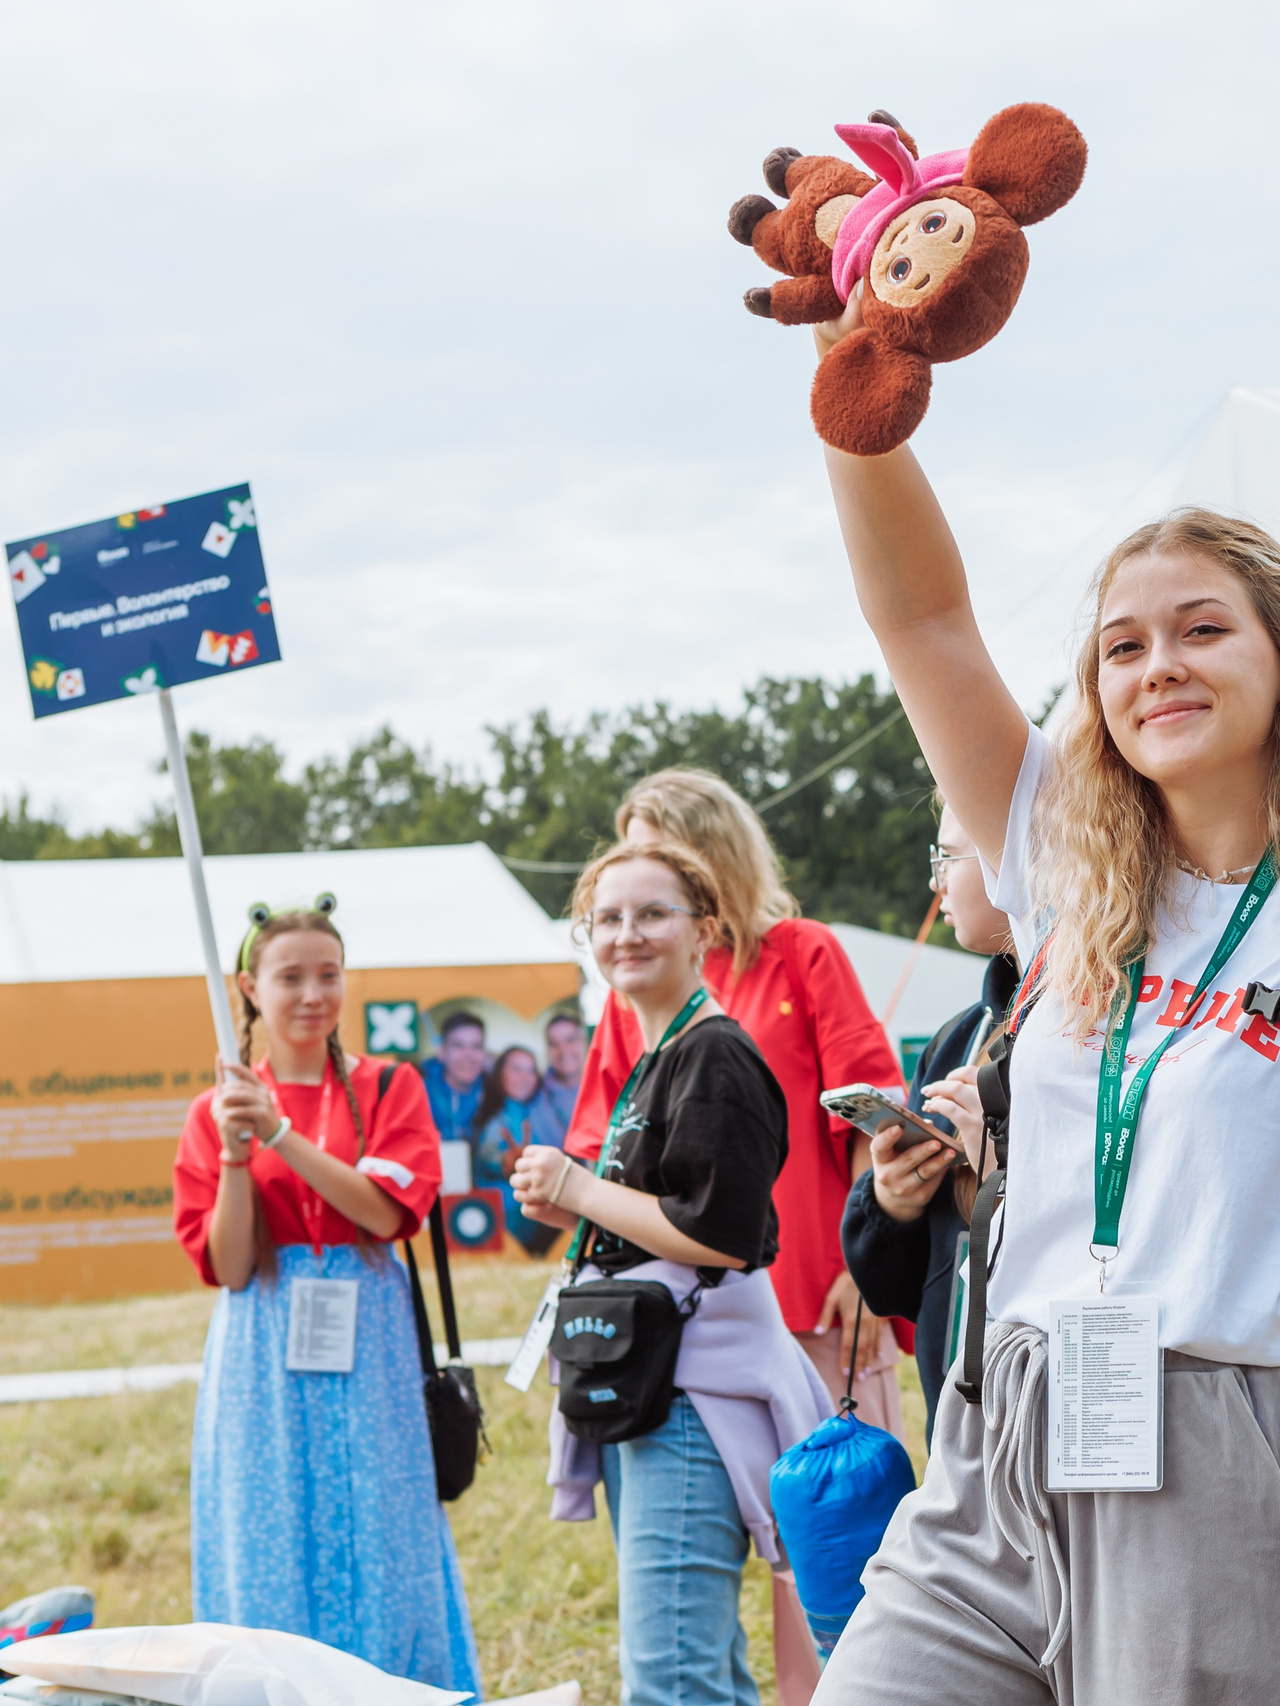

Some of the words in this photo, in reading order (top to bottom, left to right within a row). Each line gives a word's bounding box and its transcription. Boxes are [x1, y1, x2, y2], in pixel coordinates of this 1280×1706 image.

[115, 604, 189, 634] экология
[1116, 1128, 1130, 1161] iВолга
[563, 1316, 616, 1340] HELLO
